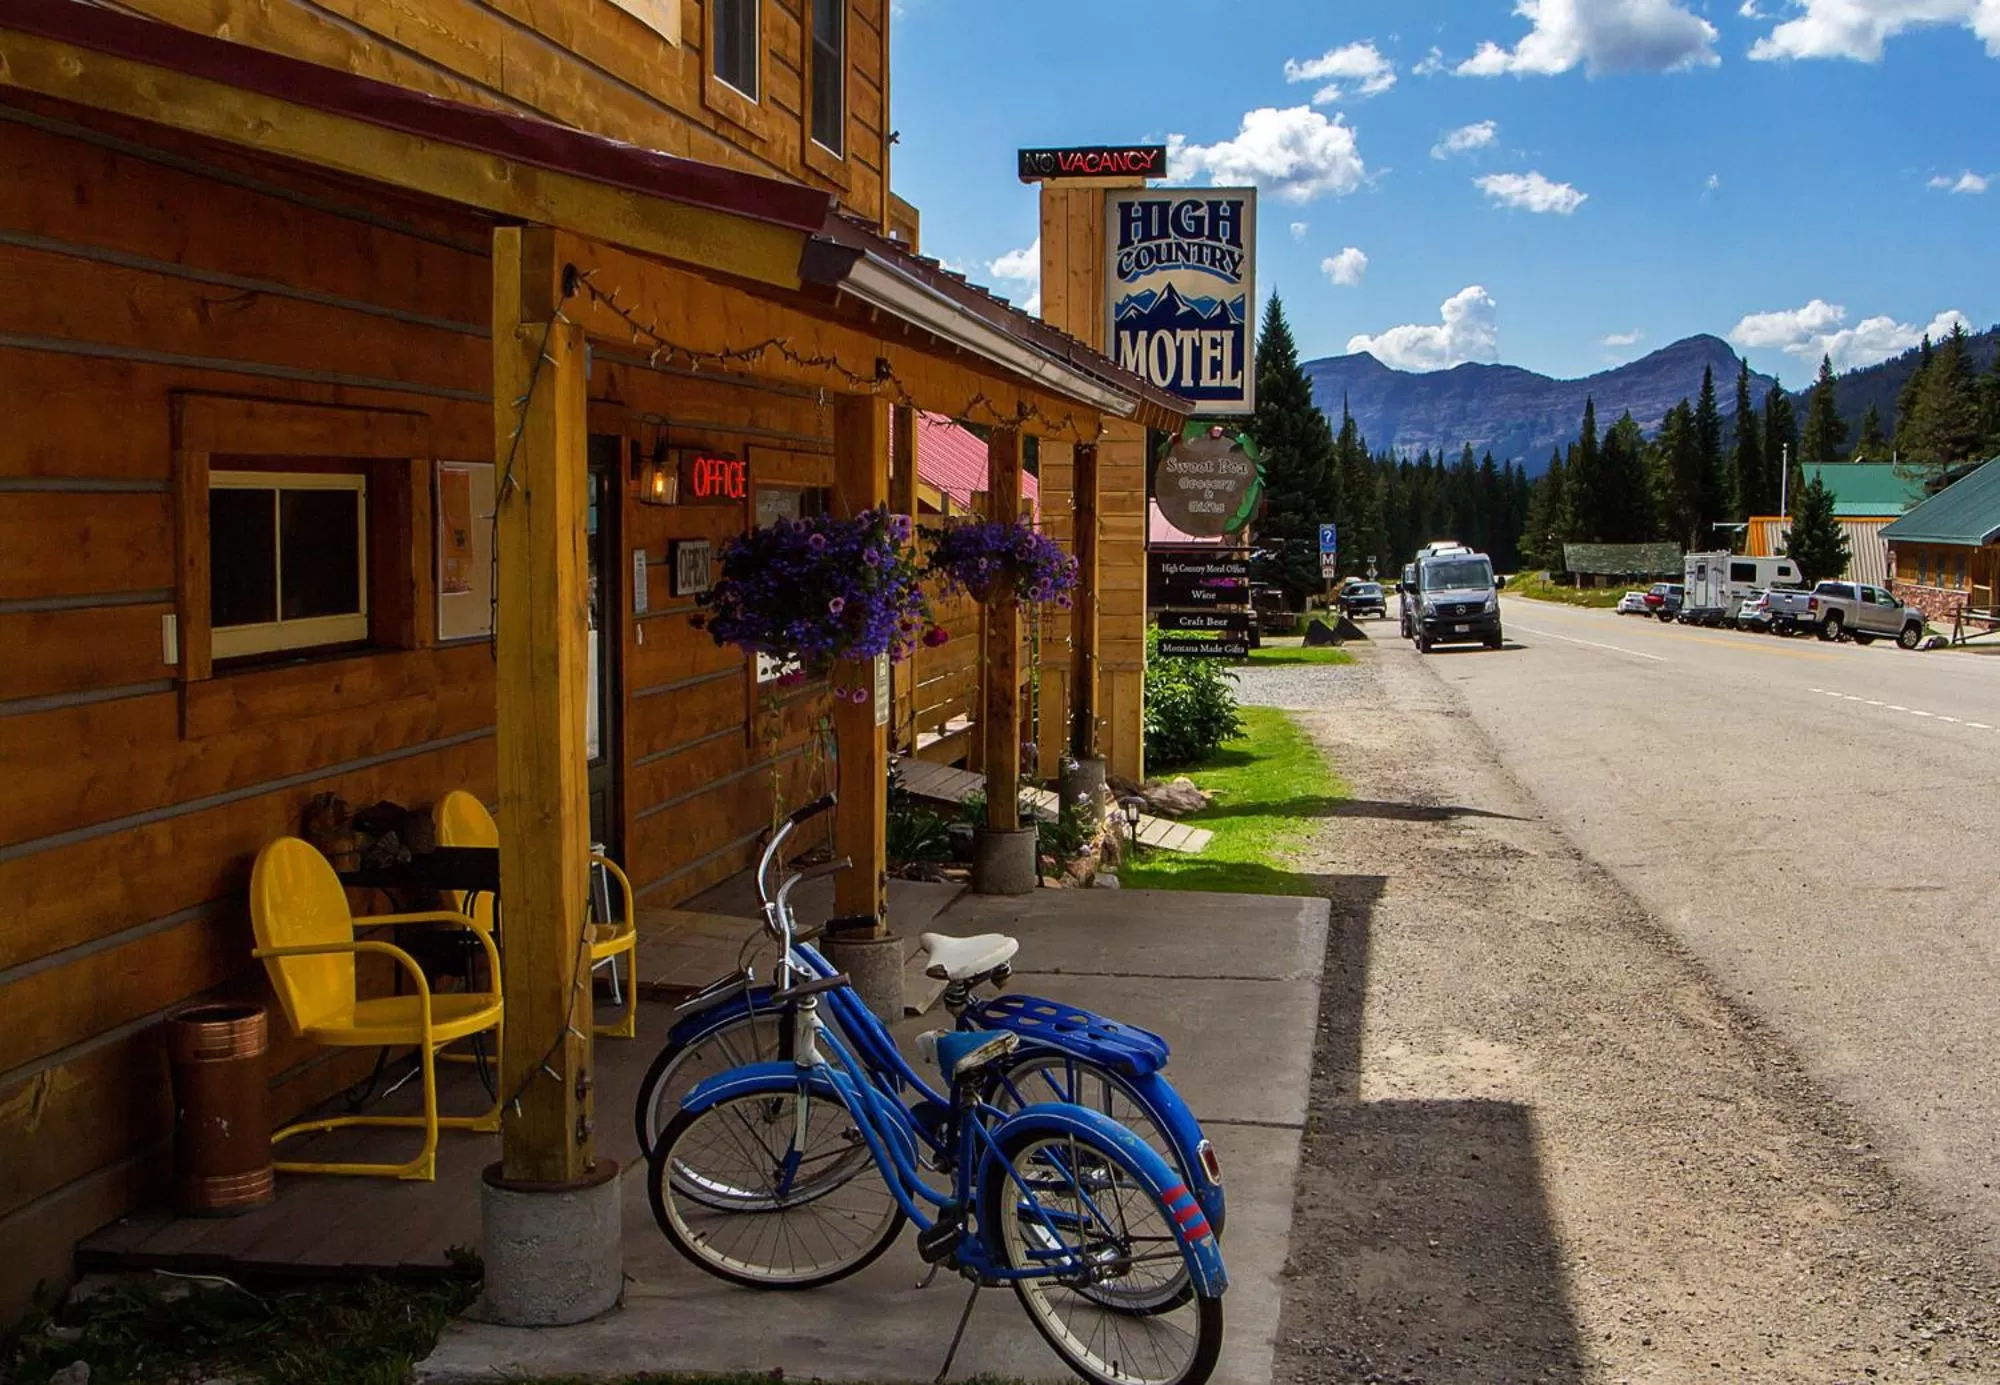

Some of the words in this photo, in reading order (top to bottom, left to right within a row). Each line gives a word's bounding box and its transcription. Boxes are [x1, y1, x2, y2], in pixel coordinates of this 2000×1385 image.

[1025, 153, 1055, 173] NO
[1058, 150, 1158, 173] VACANCY
[1117, 199, 1246, 250] HIGH
[1117, 241, 1245, 281] COUNTRY
[1119, 328, 1243, 388] MOTEL
[1166, 456, 1215, 474] Sweet
[694, 457, 746, 497] OFFICE
[680, 547, 709, 589] OPEN
[1162, 563, 1178, 574] High
[1179, 563, 1205, 575] Country
[1226, 564, 1246, 573] Office
[1191, 589, 1217, 600] Wine
[1179, 616, 1204, 626] Craft
[1206, 617, 1229, 626] Beer
[1163, 644, 1198, 653] Montana
[1200, 644, 1222, 653] Made
[1224, 644, 1245, 653] Gifts
